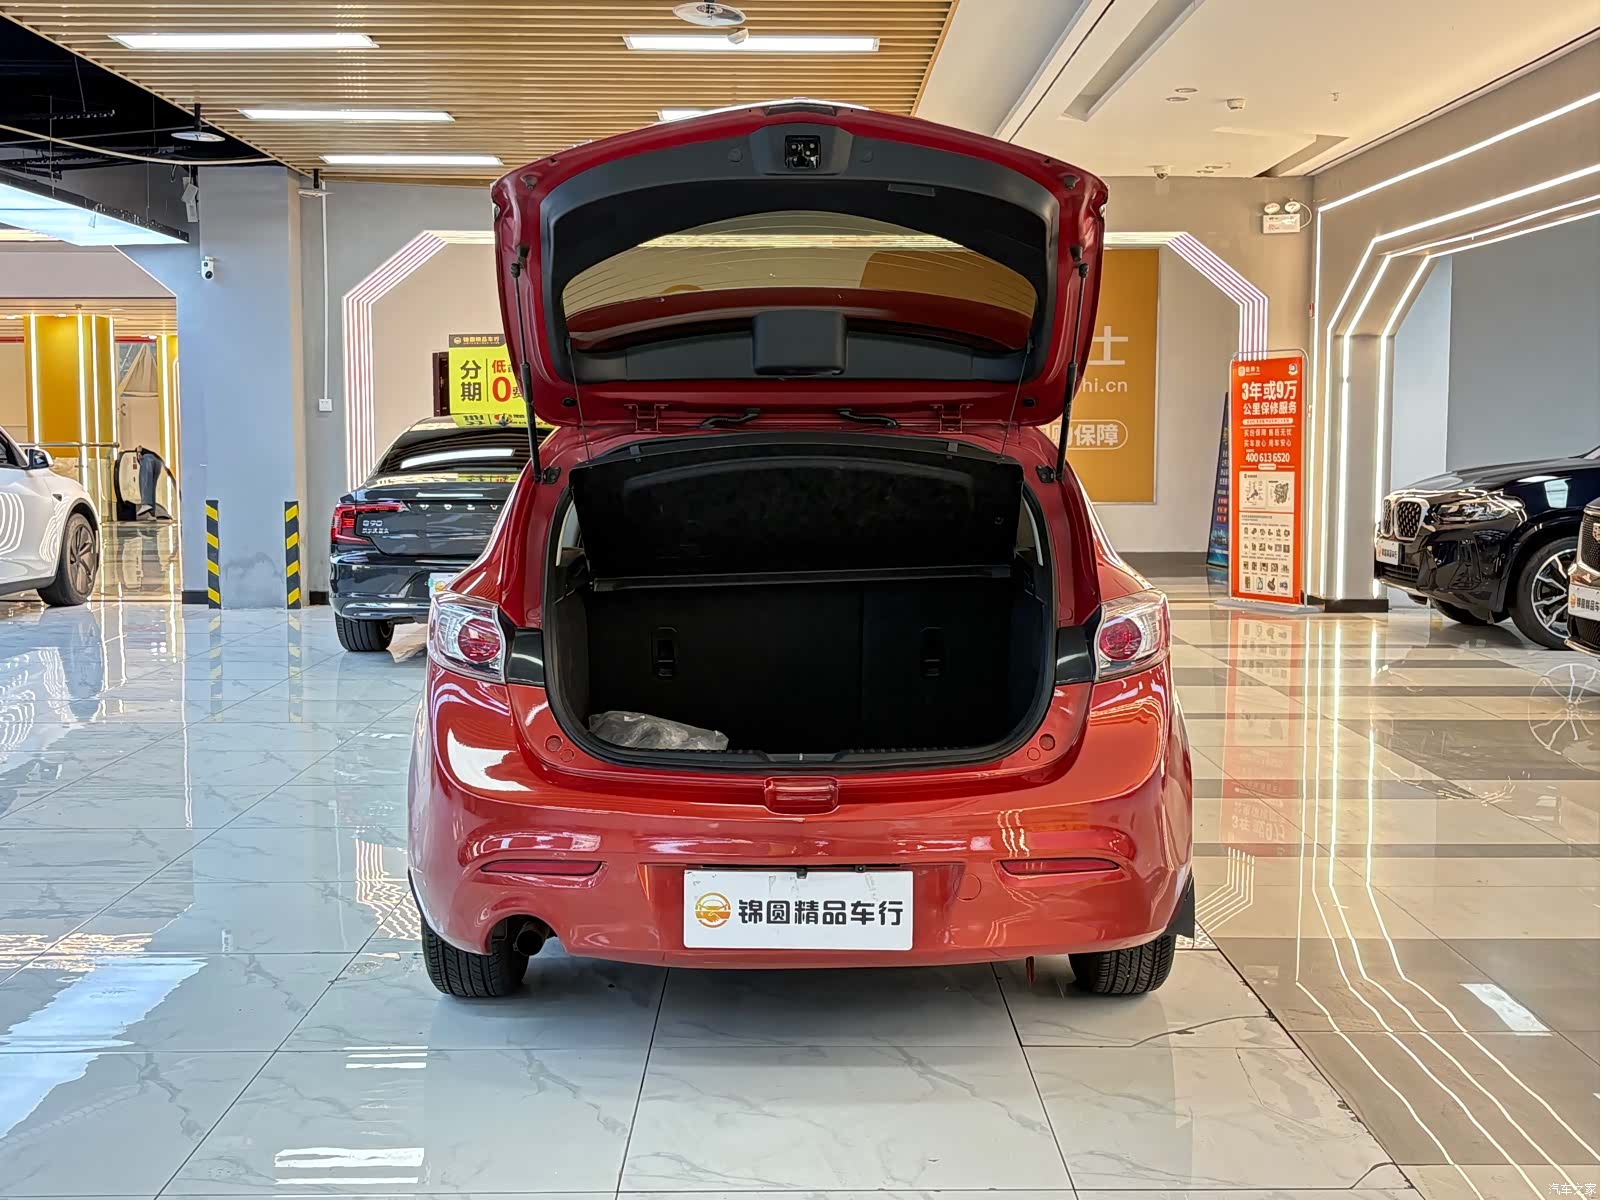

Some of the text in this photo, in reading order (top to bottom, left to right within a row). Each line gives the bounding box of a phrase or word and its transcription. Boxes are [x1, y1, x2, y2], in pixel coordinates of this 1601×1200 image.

[460, 360, 482, 401] 分期
[1078, 378, 1128, 392] hi.cn
[1242, 380, 1298, 401] 3年或9万
[1243, 401, 1297, 415] 公里保修服务
[1246, 453, 1258, 462] 400
[1259, 453, 1272, 462] 613
[738, 899, 904, 926] 锦圆精品车行
